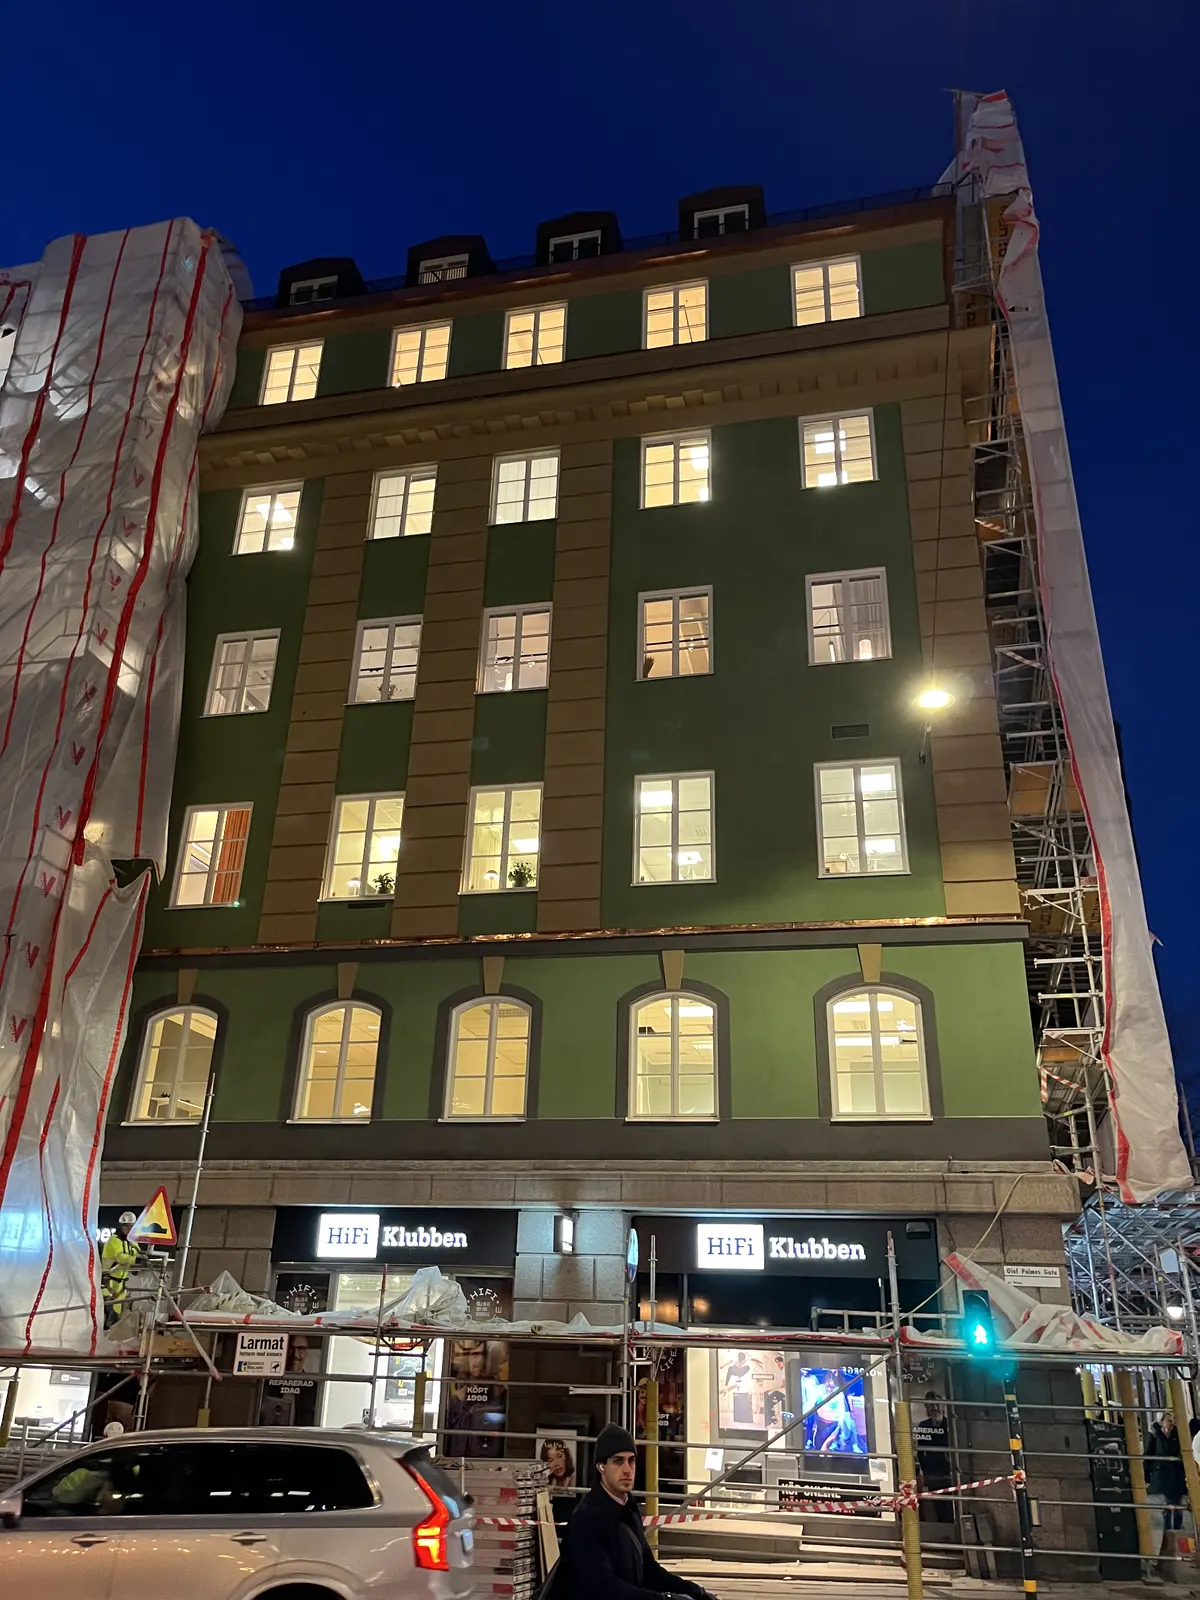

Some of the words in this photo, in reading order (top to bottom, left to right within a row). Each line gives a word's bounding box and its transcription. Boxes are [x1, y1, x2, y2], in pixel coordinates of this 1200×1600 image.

[327, 1227, 369, 1245] HiFi
[382, 1225, 468, 1248] Klubben
[707, 1237, 755, 1256] HiFi
[768, 1236, 867, 1260] Klubben
[289, 1283, 316, 1297] HIFI
[469, 1287, 498, 1302] HIFI
[240, 1335, 284, 1350] Larmat
[660, 1348, 678, 1372] LIFE
[268, 1379, 314, 1387] REPARERAD
[467, 1385, 489, 1394] KÖPT
[803, 1484, 841, 1499] ONLINE
